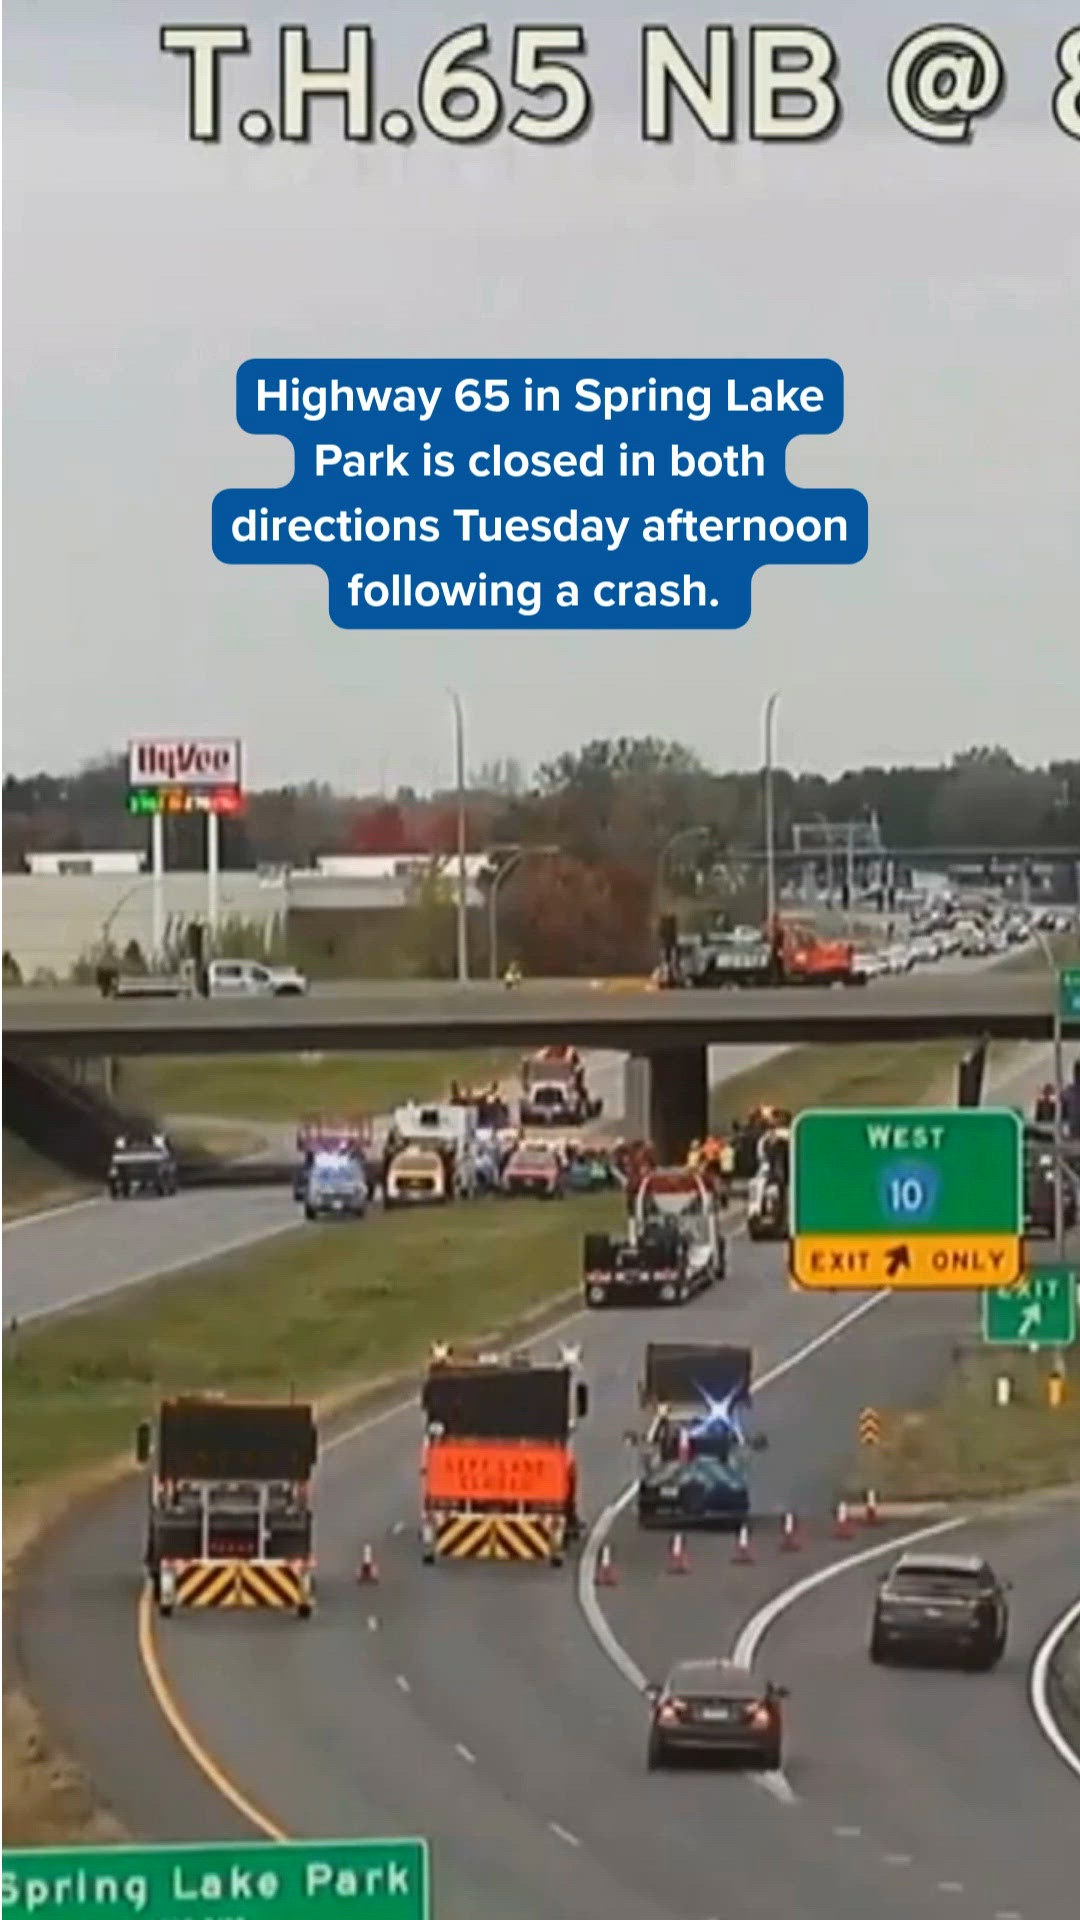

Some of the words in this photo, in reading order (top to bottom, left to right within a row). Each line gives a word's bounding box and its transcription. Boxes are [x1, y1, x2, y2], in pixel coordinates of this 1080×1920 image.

[866, 1122, 945, 1150] WEST
[888, 1177, 923, 1211] 10
[810, 1251, 870, 1271] EXIT
[931, 1250, 1006, 1271] ONLY
[2, 1867, 148, 1912] Spring
[173, 1864, 279, 1900] Lake
[305, 1861, 410, 1897] Park
